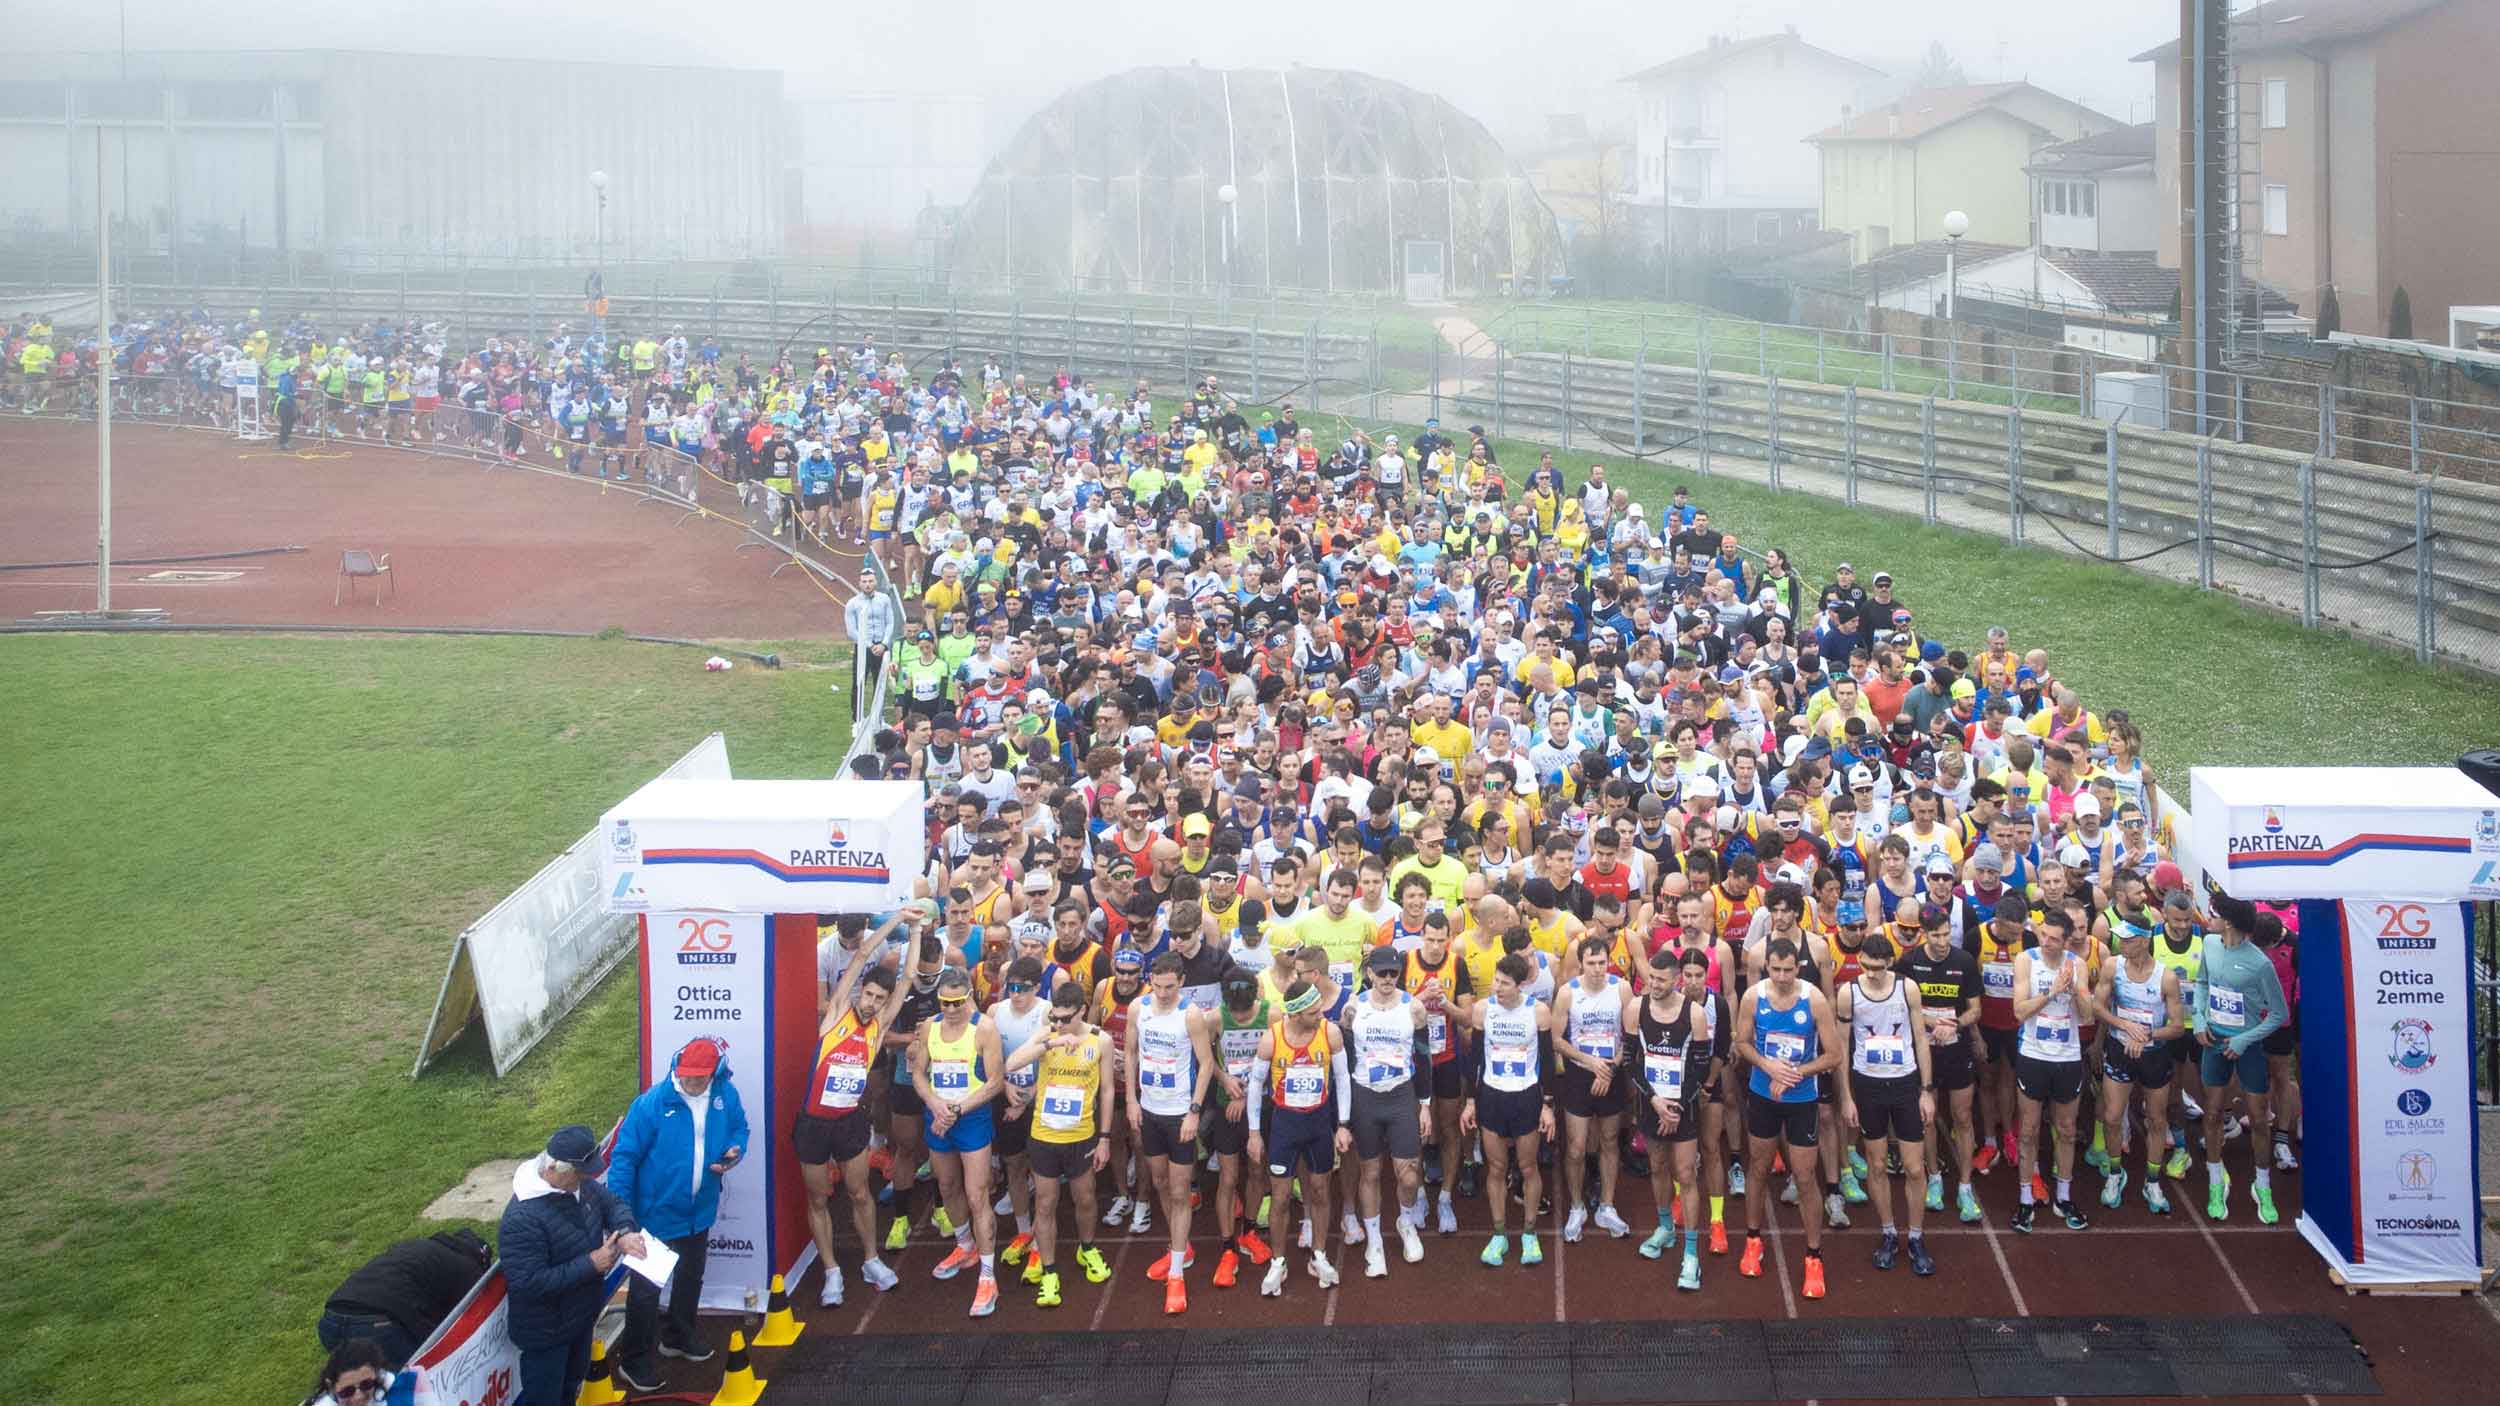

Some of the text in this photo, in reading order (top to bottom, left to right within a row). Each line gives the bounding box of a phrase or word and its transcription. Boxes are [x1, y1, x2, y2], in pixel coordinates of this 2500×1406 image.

[2228, 834, 2324, 853] PARTENZA
[790, 849, 886, 868] PARTENZA
[2376, 903, 2431, 937] 2G
[678, 918, 734, 952] 2G
[2383, 939, 2432, 948] INFISSI
[683, 953, 732, 964] INFISSI
[1988, 973, 2012, 985] 601
[2379, 969, 2434, 985] Ottica
[677, 985, 732, 1001] Ottica
[2376, 989, 2445, 1005] 2emme
[2215, 998, 2236, 1011] 196
[673, 1005, 742, 1021] 2emme
[2050, 1028, 2058, 1038] 5
[1591, 1047, 1600, 1057] 4
[1647, 1043, 1681, 1056] Grottini
[1776, 1044, 1793, 1058] 29
[1878, 1050, 1893, 1062] 18
[1504, 1063, 1513, 1073] 6
[942, 1073, 958, 1085] 51
[1153, 1072, 1162, 1084] 8
[1655, 1069, 1670, 1082] 36
[832, 1077, 859, 1091] 596
[1292, 1077, 1317, 1090] 590
[1054, 1099, 1072, 1112] 53
[2376, 1216, 2461, 1230] TECNOSONDA
